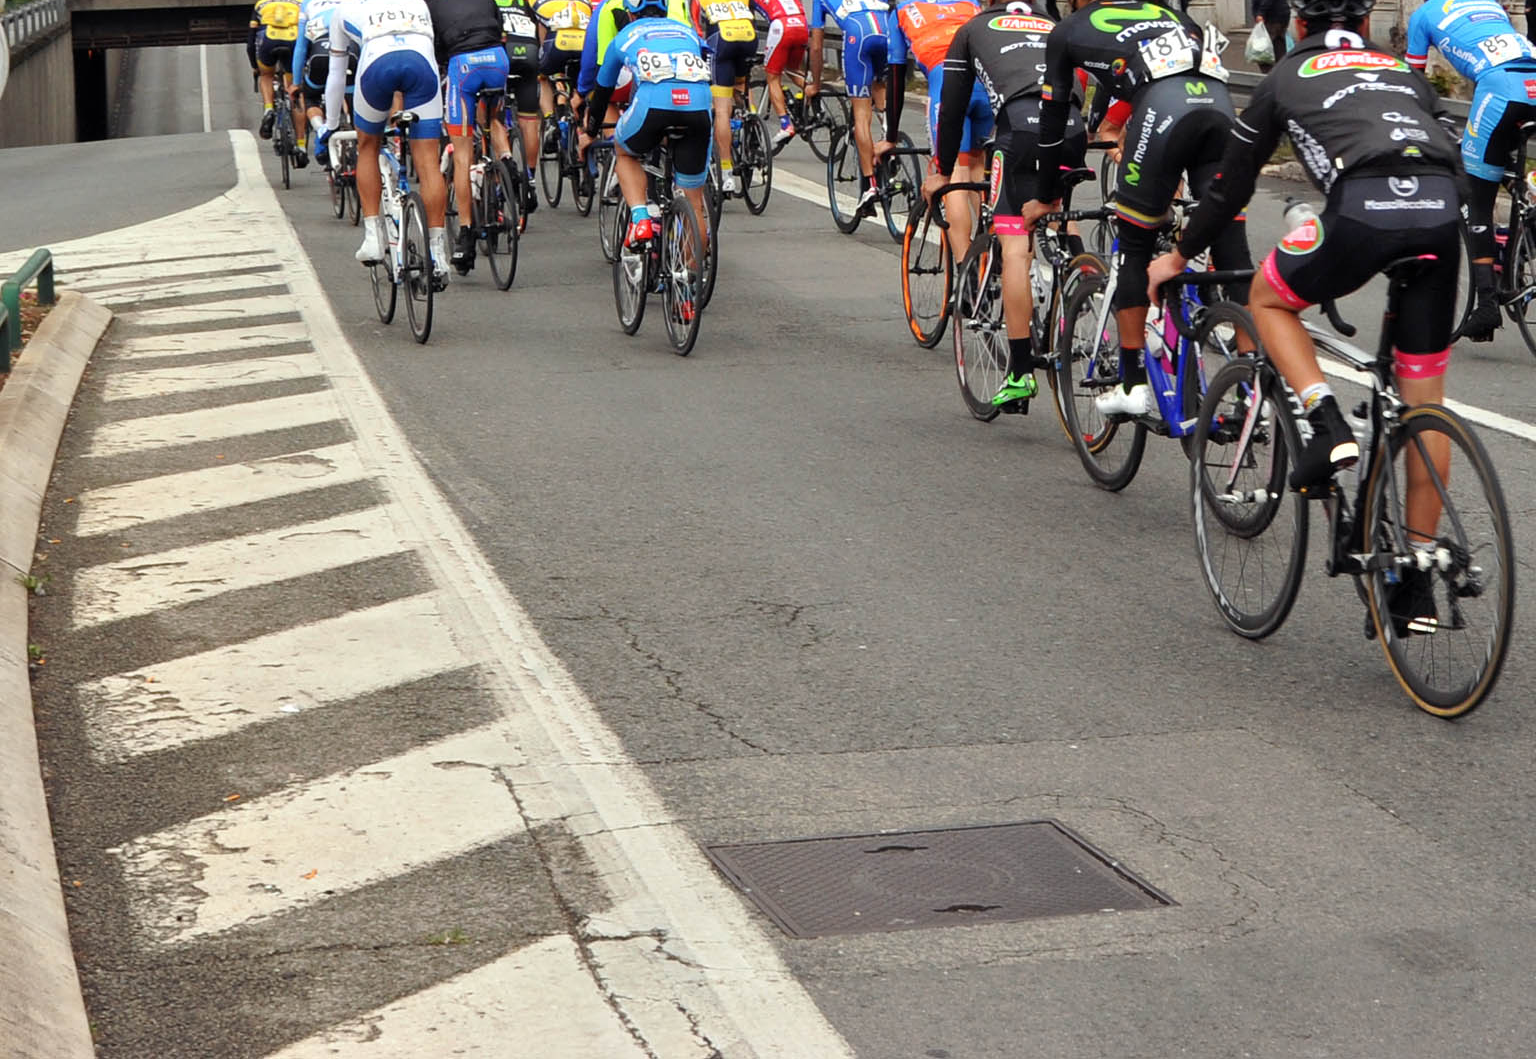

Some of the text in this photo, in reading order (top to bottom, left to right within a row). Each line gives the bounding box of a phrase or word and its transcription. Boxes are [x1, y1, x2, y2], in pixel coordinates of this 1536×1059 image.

[1144, 28, 1191, 62] 181
[1483, 36, 1508, 54] 85
[640, 55, 662, 72] 86
[1133, 107, 1157, 163] movistar
